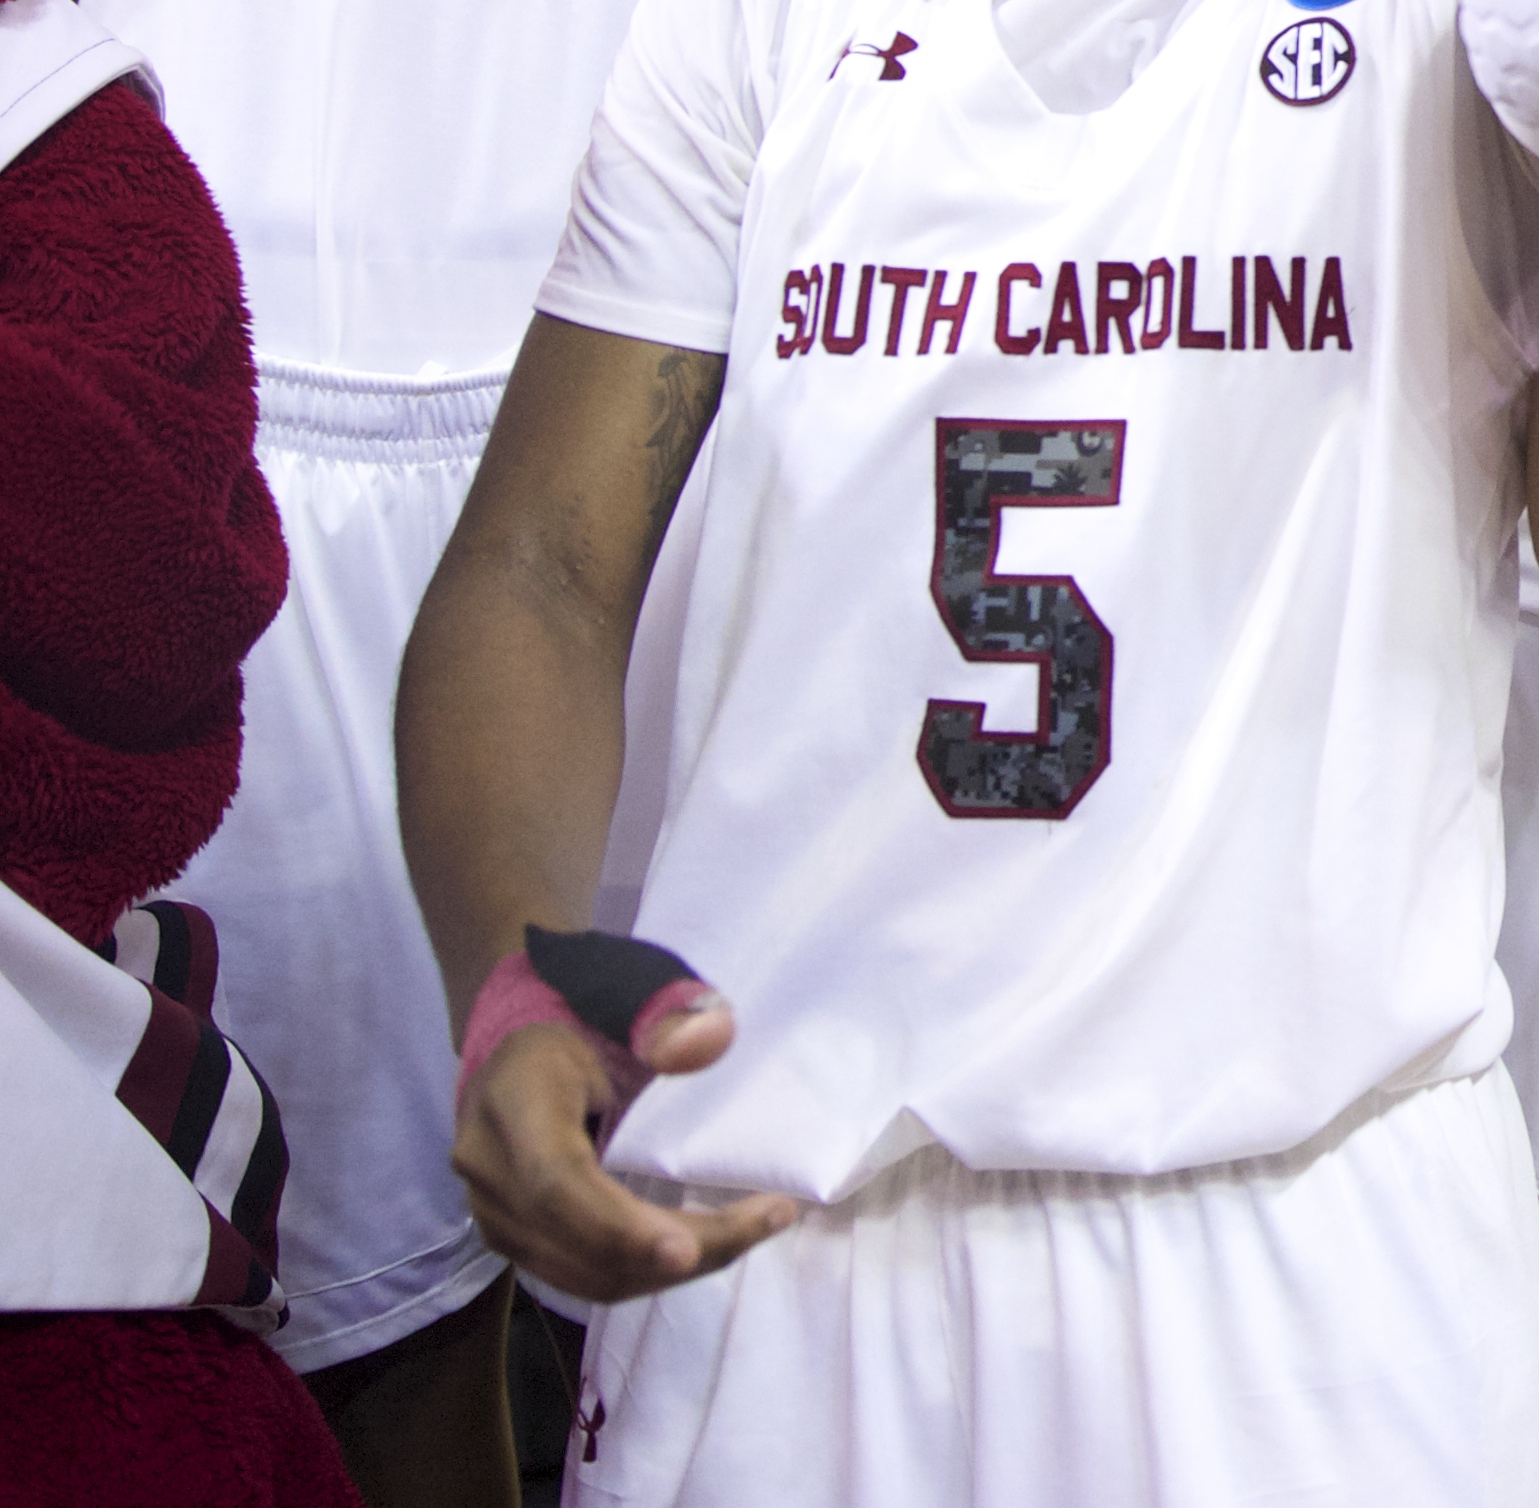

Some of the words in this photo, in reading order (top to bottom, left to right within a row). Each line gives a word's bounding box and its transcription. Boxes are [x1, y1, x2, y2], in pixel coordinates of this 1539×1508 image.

[1266, 22, 1350, 101] SEC
[777, 262, 977, 359] SOUTH
[995, 255, 1353, 356] CAROLINA
[916, 416, 1128, 820] 5
